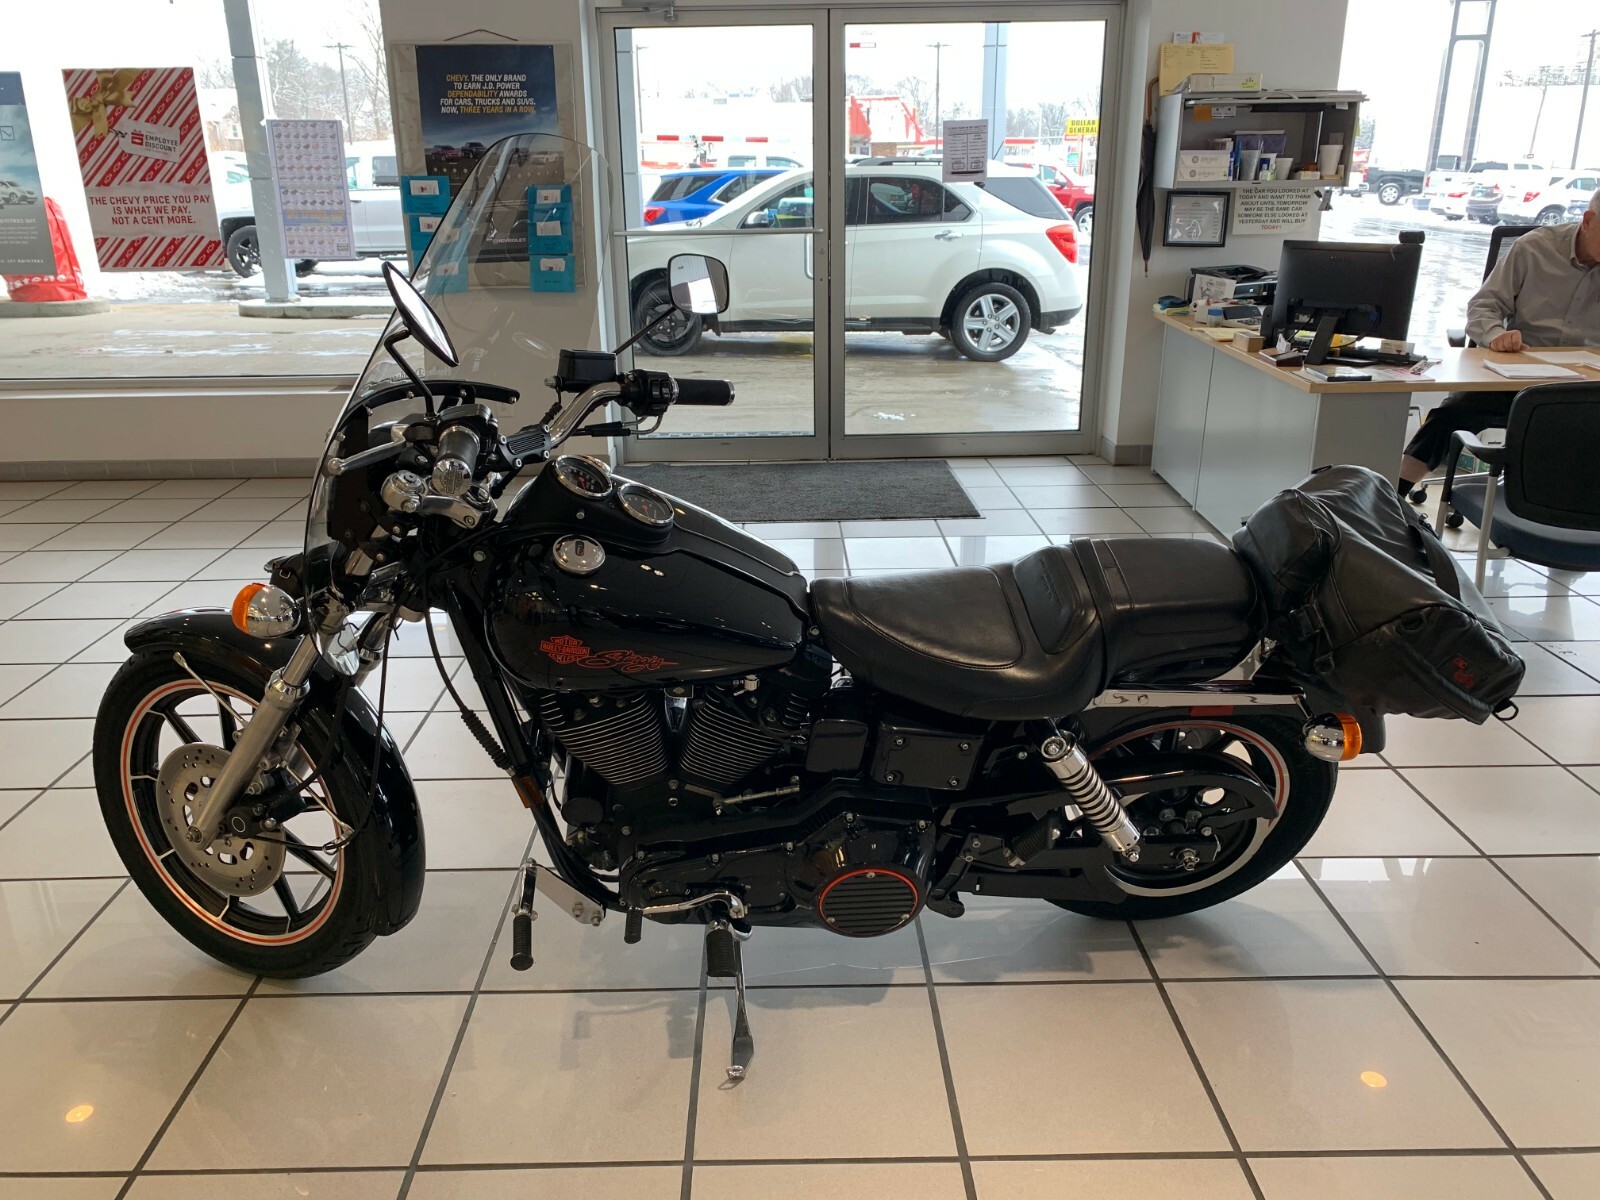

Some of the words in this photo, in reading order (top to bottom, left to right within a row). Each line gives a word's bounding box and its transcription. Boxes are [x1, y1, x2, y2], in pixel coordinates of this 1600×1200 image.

[446, 74, 470, 82] CHEVY.
[471, 74, 483, 82] THE
[485, 74, 502, 82] ONLY
[504, 74, 526, 82] BRAND
[448, 90, 498, 98] DEPENDABILITY
[499, 90, 527, 98] AWARDS
[440, 98, 453, 106] FOR
[454, 98, 473, 106] CARS,
[475, 98, 500, 106] TRUCKS
[502, 98, 515, 106] AND
[516, 98, 536, 106] SUVS.
[441, 106, 458, 114] NOW,
[145, 135, 178, 146] EMPLOYEE
[145, 141, 176, 152] DISCOUNT
[89, 197, 107, 205] THE
[110, 196, 140, 205] CHEVY
[143, 195, 170, 204] PRICE
[172, 195, 191, 204] YOU
[193, 195, 210, 203] PAY
[113, 206, 122, 215] IS
[124, 206, 151, 214] WHAT
[154, 206, 169, 214] WE
[171, 206, 191, 214] PAY.
[111, 216, 130, 225] NOT
[133, 216, 139, 225] A
[141, 216, 164, 225] CENT
[167, 216, 196, 224] MORE.
[555, 637, 578, 646] MOTOR
[542, 642, 588, 655] HARLEY-DAVIDSON
